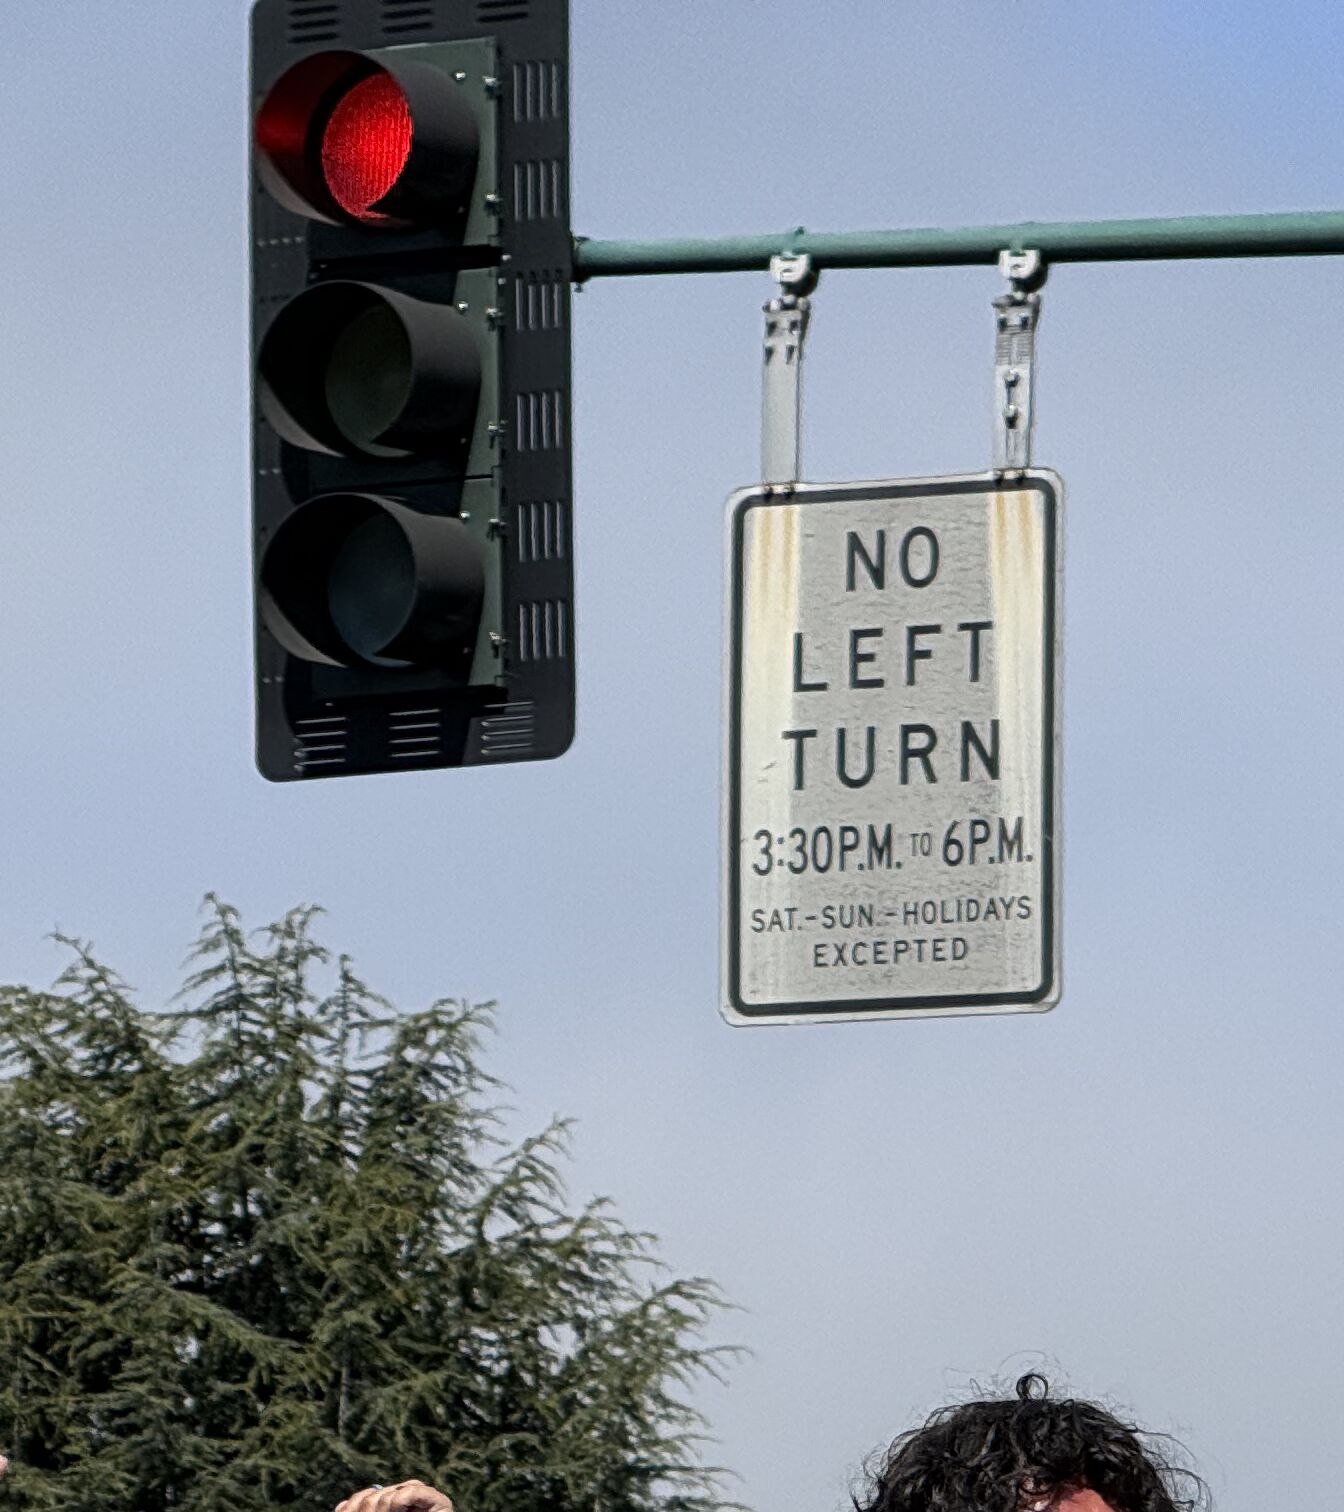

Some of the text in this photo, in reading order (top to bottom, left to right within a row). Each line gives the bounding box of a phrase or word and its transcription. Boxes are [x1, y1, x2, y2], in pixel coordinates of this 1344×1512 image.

[846, 526, 940, 593] NO
[793, 620, 994, 693] LEFT
[782, 718, 1001, 792] TURN
[752, 816, 1034, 877] 3:30P.M. TO 6P.M.
[813, 936, 970, 969] EXCEPTED
